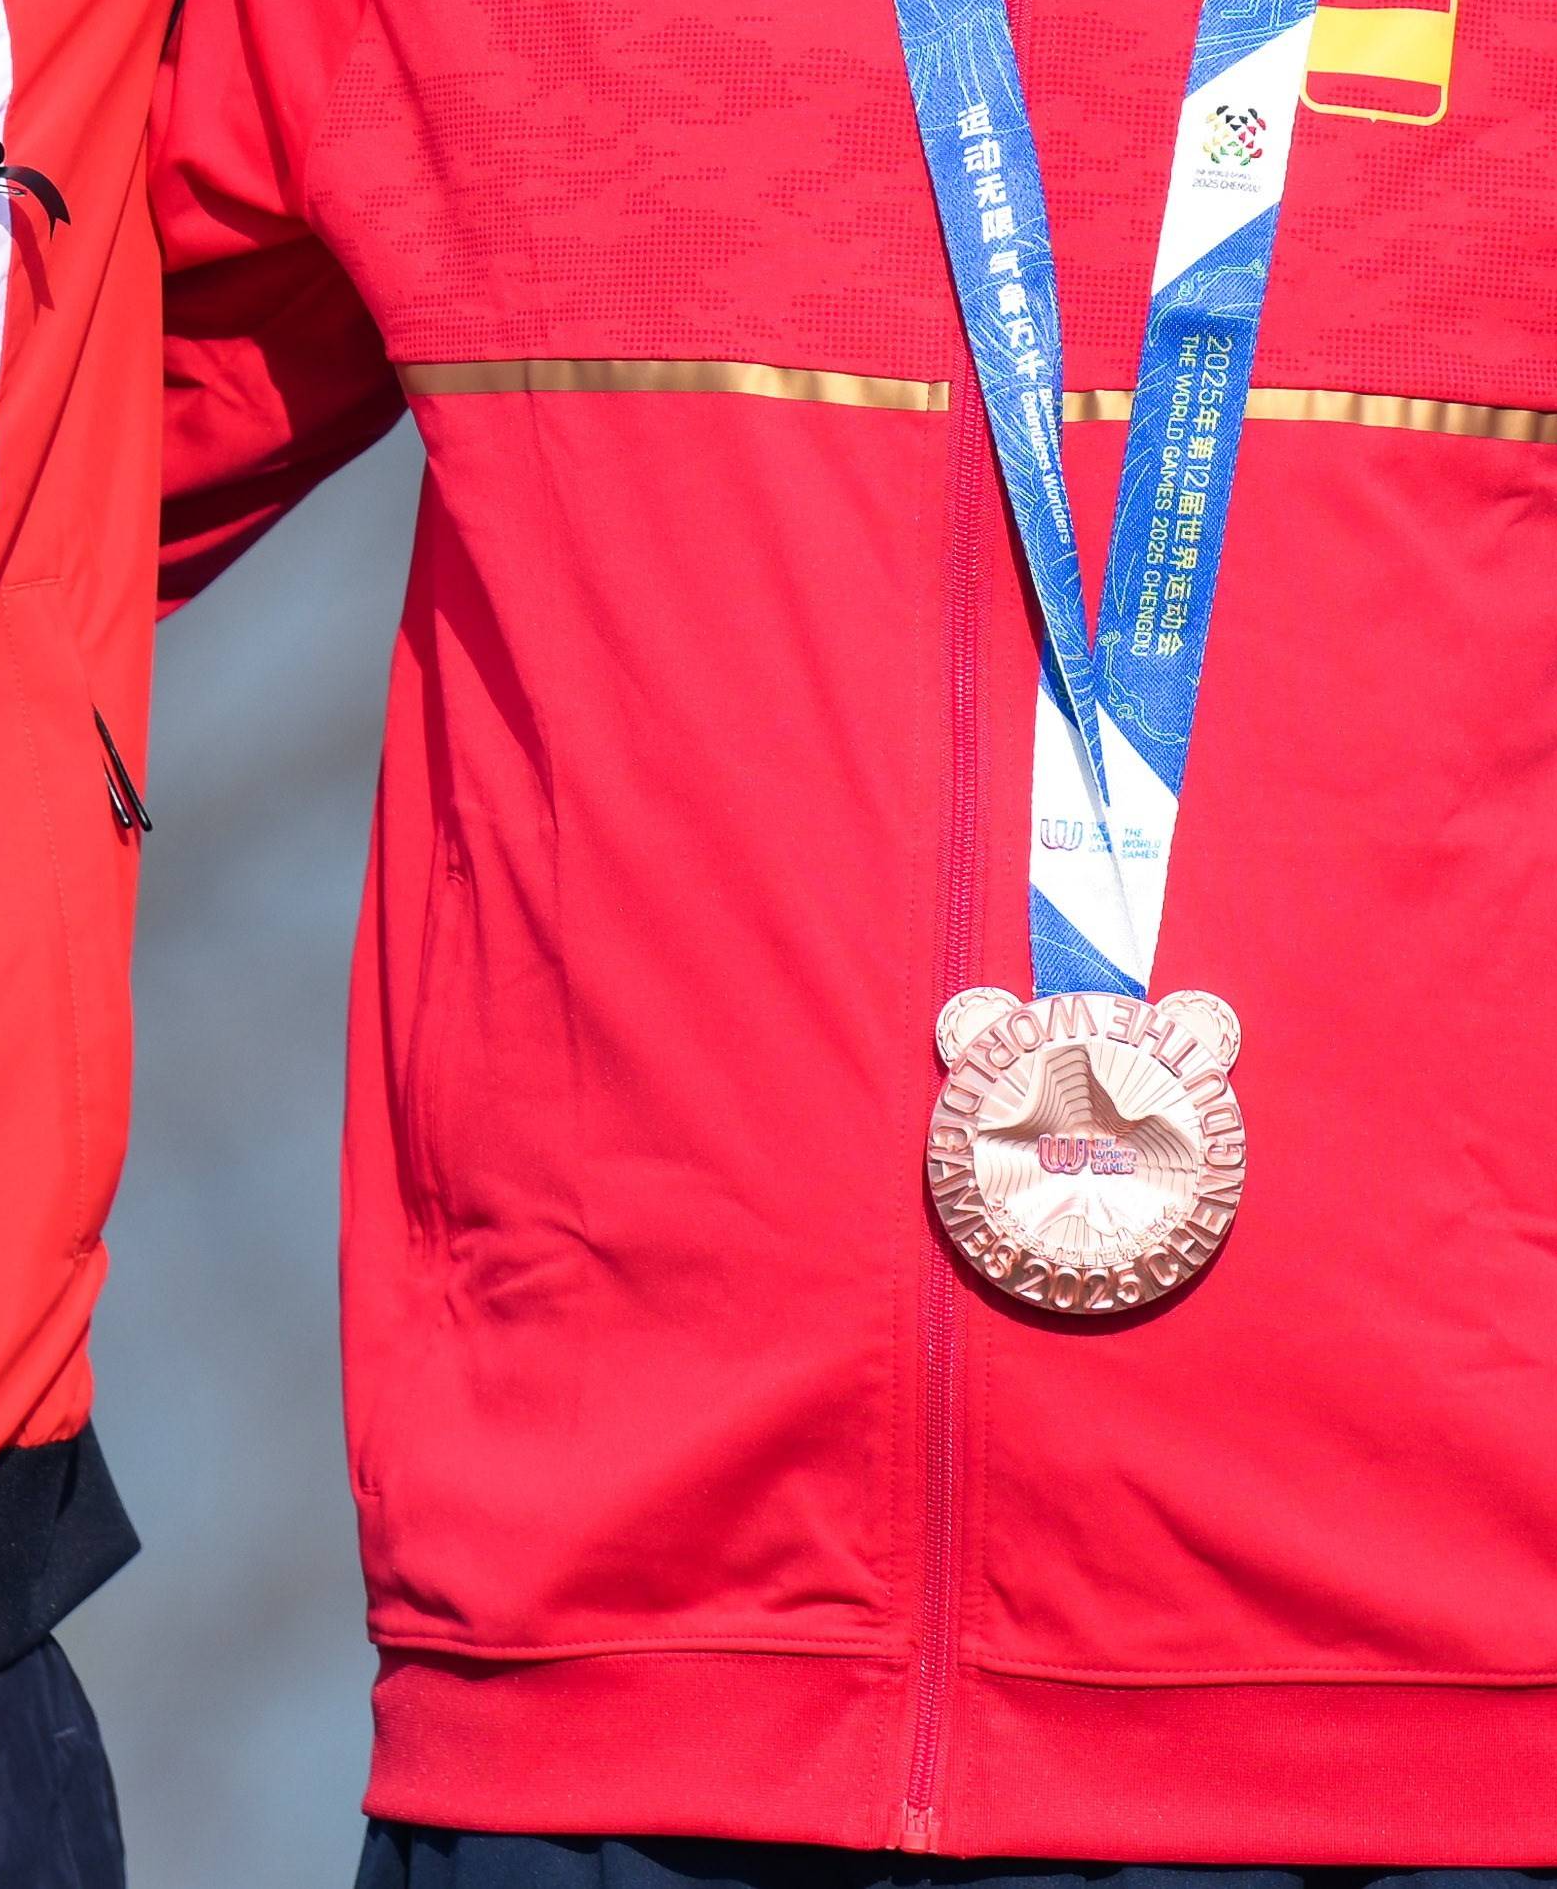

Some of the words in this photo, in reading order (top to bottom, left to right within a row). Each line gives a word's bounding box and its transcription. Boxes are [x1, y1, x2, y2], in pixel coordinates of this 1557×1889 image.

[957, 103, 1017, 243] 运动无限
[1178, 333, 1201, 370] THE
[1165, 371, 1194, 442] WORLD
[1041, 472, 1072, 545] Wonders
[1154, 335, 1233, 658] 2025年第12届世界运动会
[1155, 444, 1182, 511] GAMES
[1146, 516, 1170, 566] 2025
[1130, 569, 1163, 658] CHENGDU
[939, 994, 1098, 1116] WORLD
[1107, 997, 1197, 1078] THE
[929, 1125, 1021, 1290] GAMES
[1143, 1067, 1246, 1287] CHENGDU
[1015, 1259, 1141, 1309] 2025
